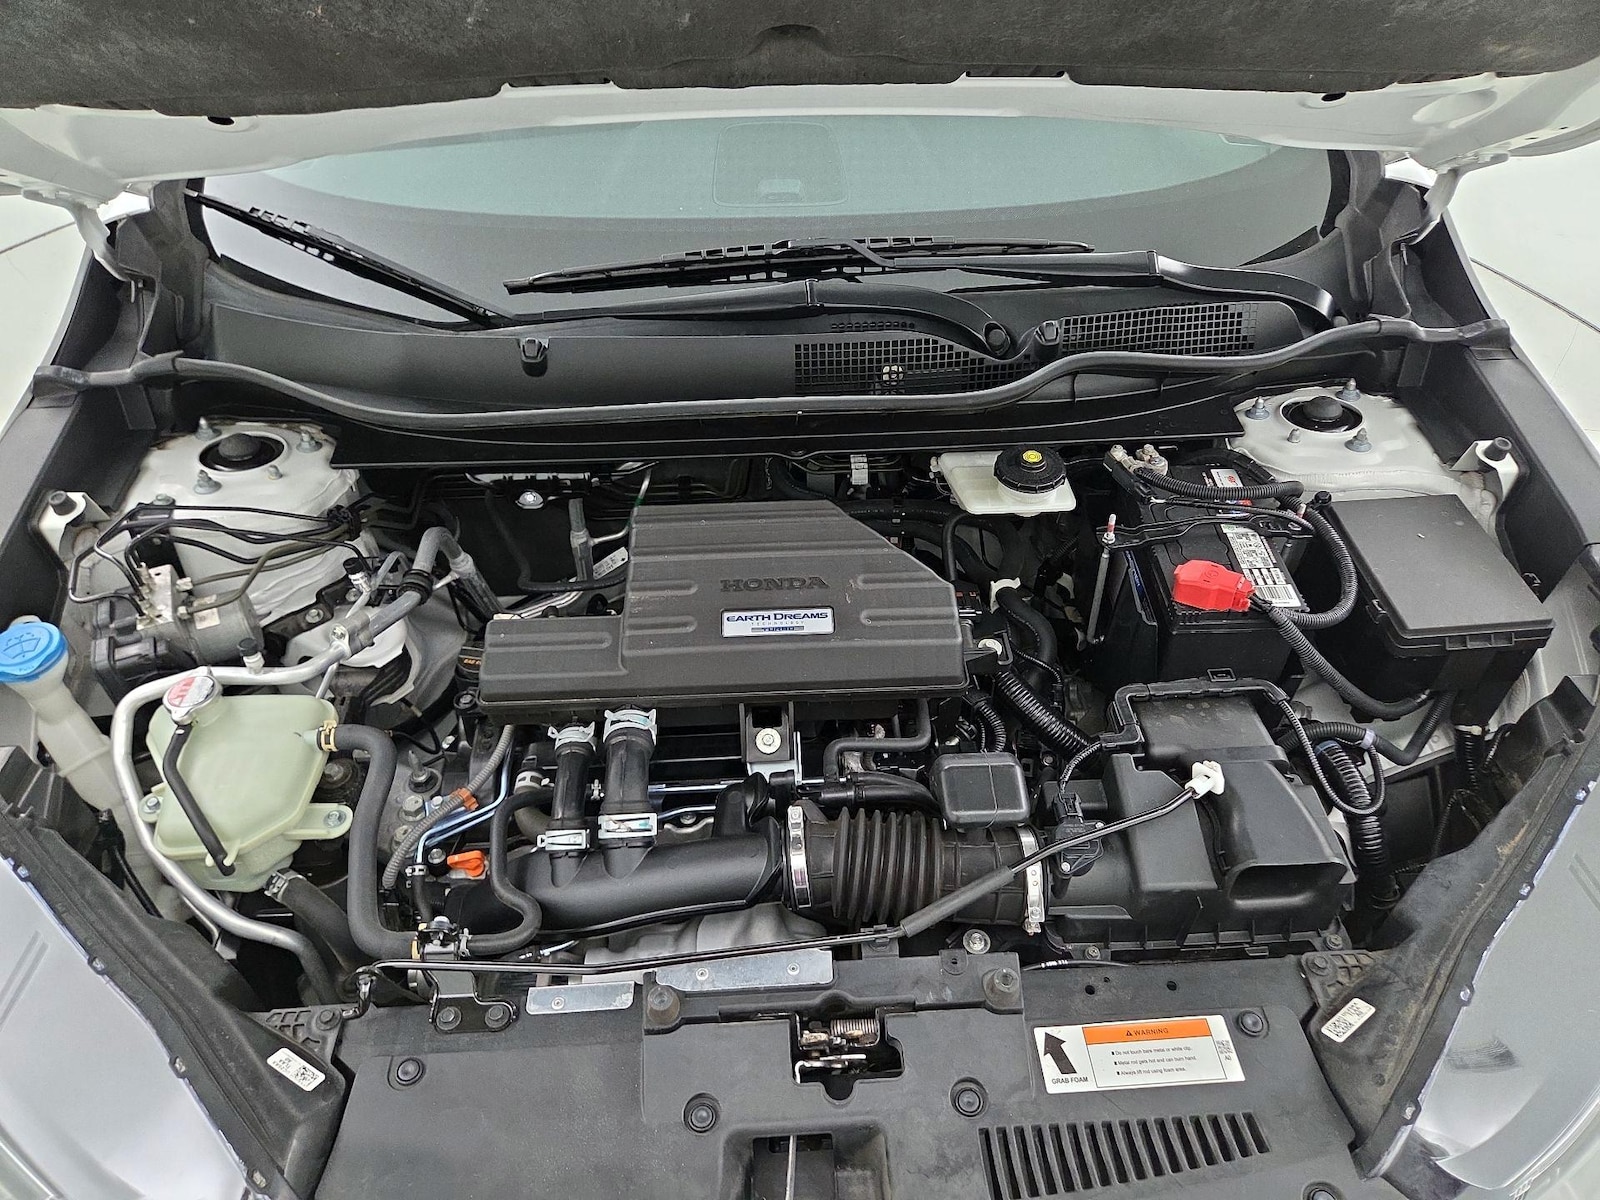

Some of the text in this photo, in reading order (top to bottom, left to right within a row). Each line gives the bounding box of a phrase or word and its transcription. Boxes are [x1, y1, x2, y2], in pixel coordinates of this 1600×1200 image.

[720, 577, 831, 592] HONDA
[727, 612, 829, 622] EARTH DREAMS
[1133, 1027, 1169, 1036] WARNING
